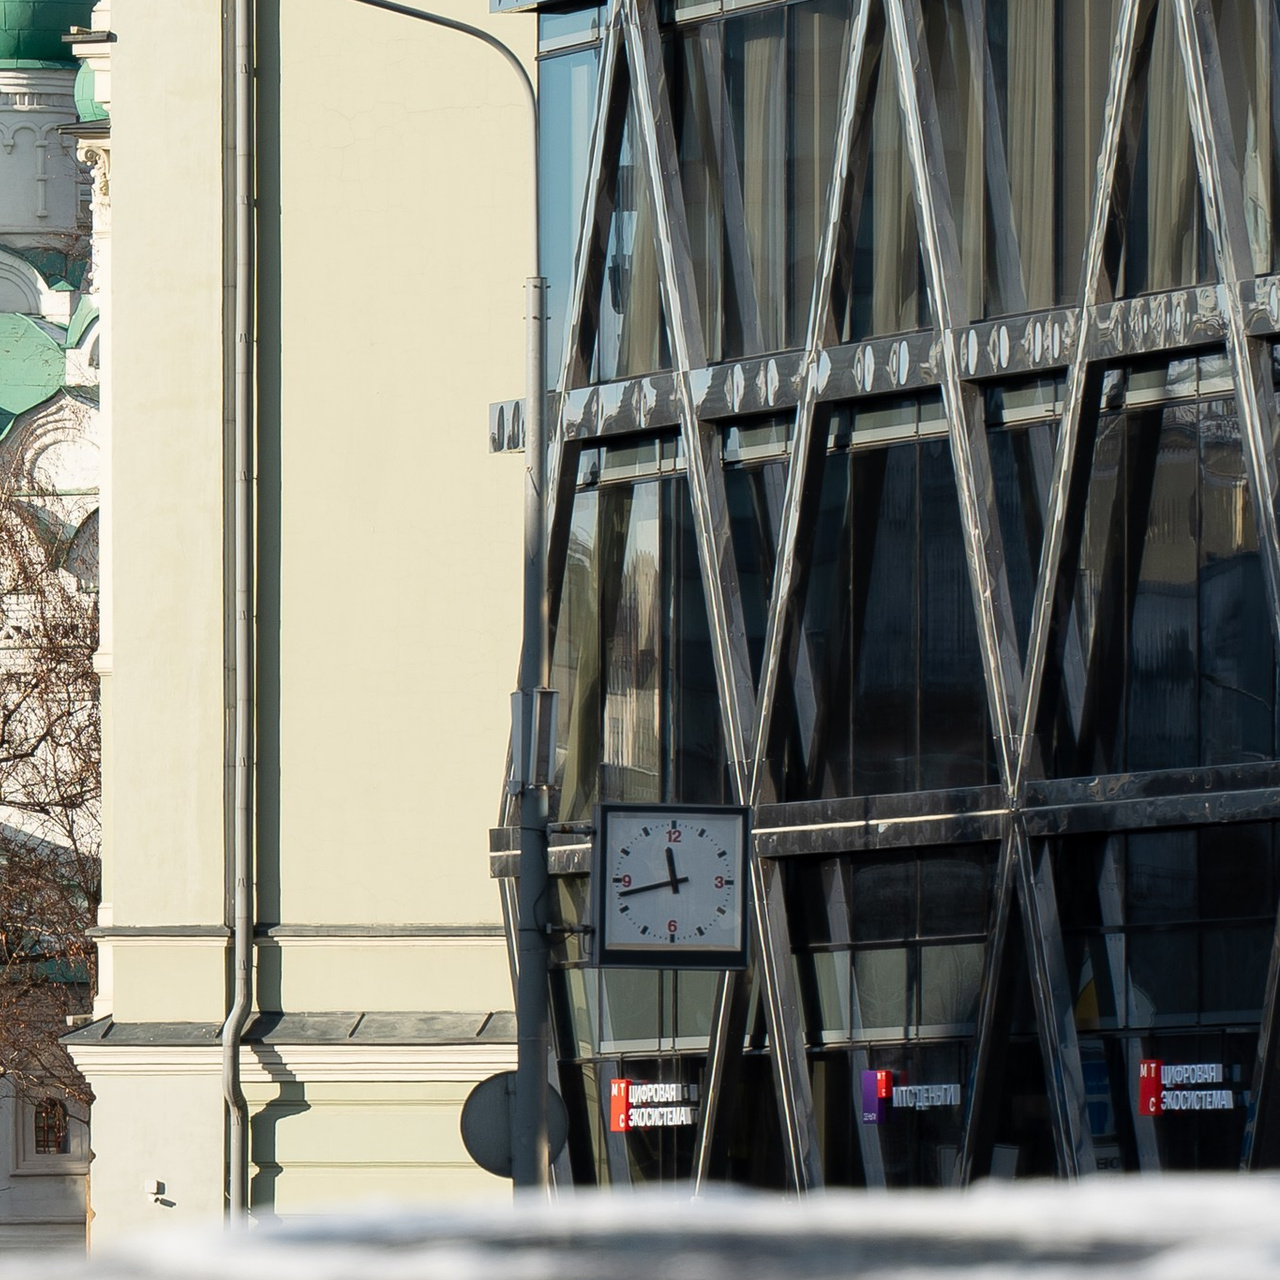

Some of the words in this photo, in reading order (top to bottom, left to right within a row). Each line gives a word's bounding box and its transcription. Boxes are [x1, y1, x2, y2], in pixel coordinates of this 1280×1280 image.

[666, 830, 681, 843] 12
[622, 874, 632, 888] 9
[714, 876, 724, 889] 3
[667, 920, 677, 933] 6
[1161, 1064, 1219, 1088] ЦИФРОВАЯ
[628, 1084, 678, 1106] ЦИФРОВАЯ
[1161, 1090, 1229, 1110] ЭКОСИСТЕМА
[628, 1107, 688, 1127] ЭКОСИСТЕМА
